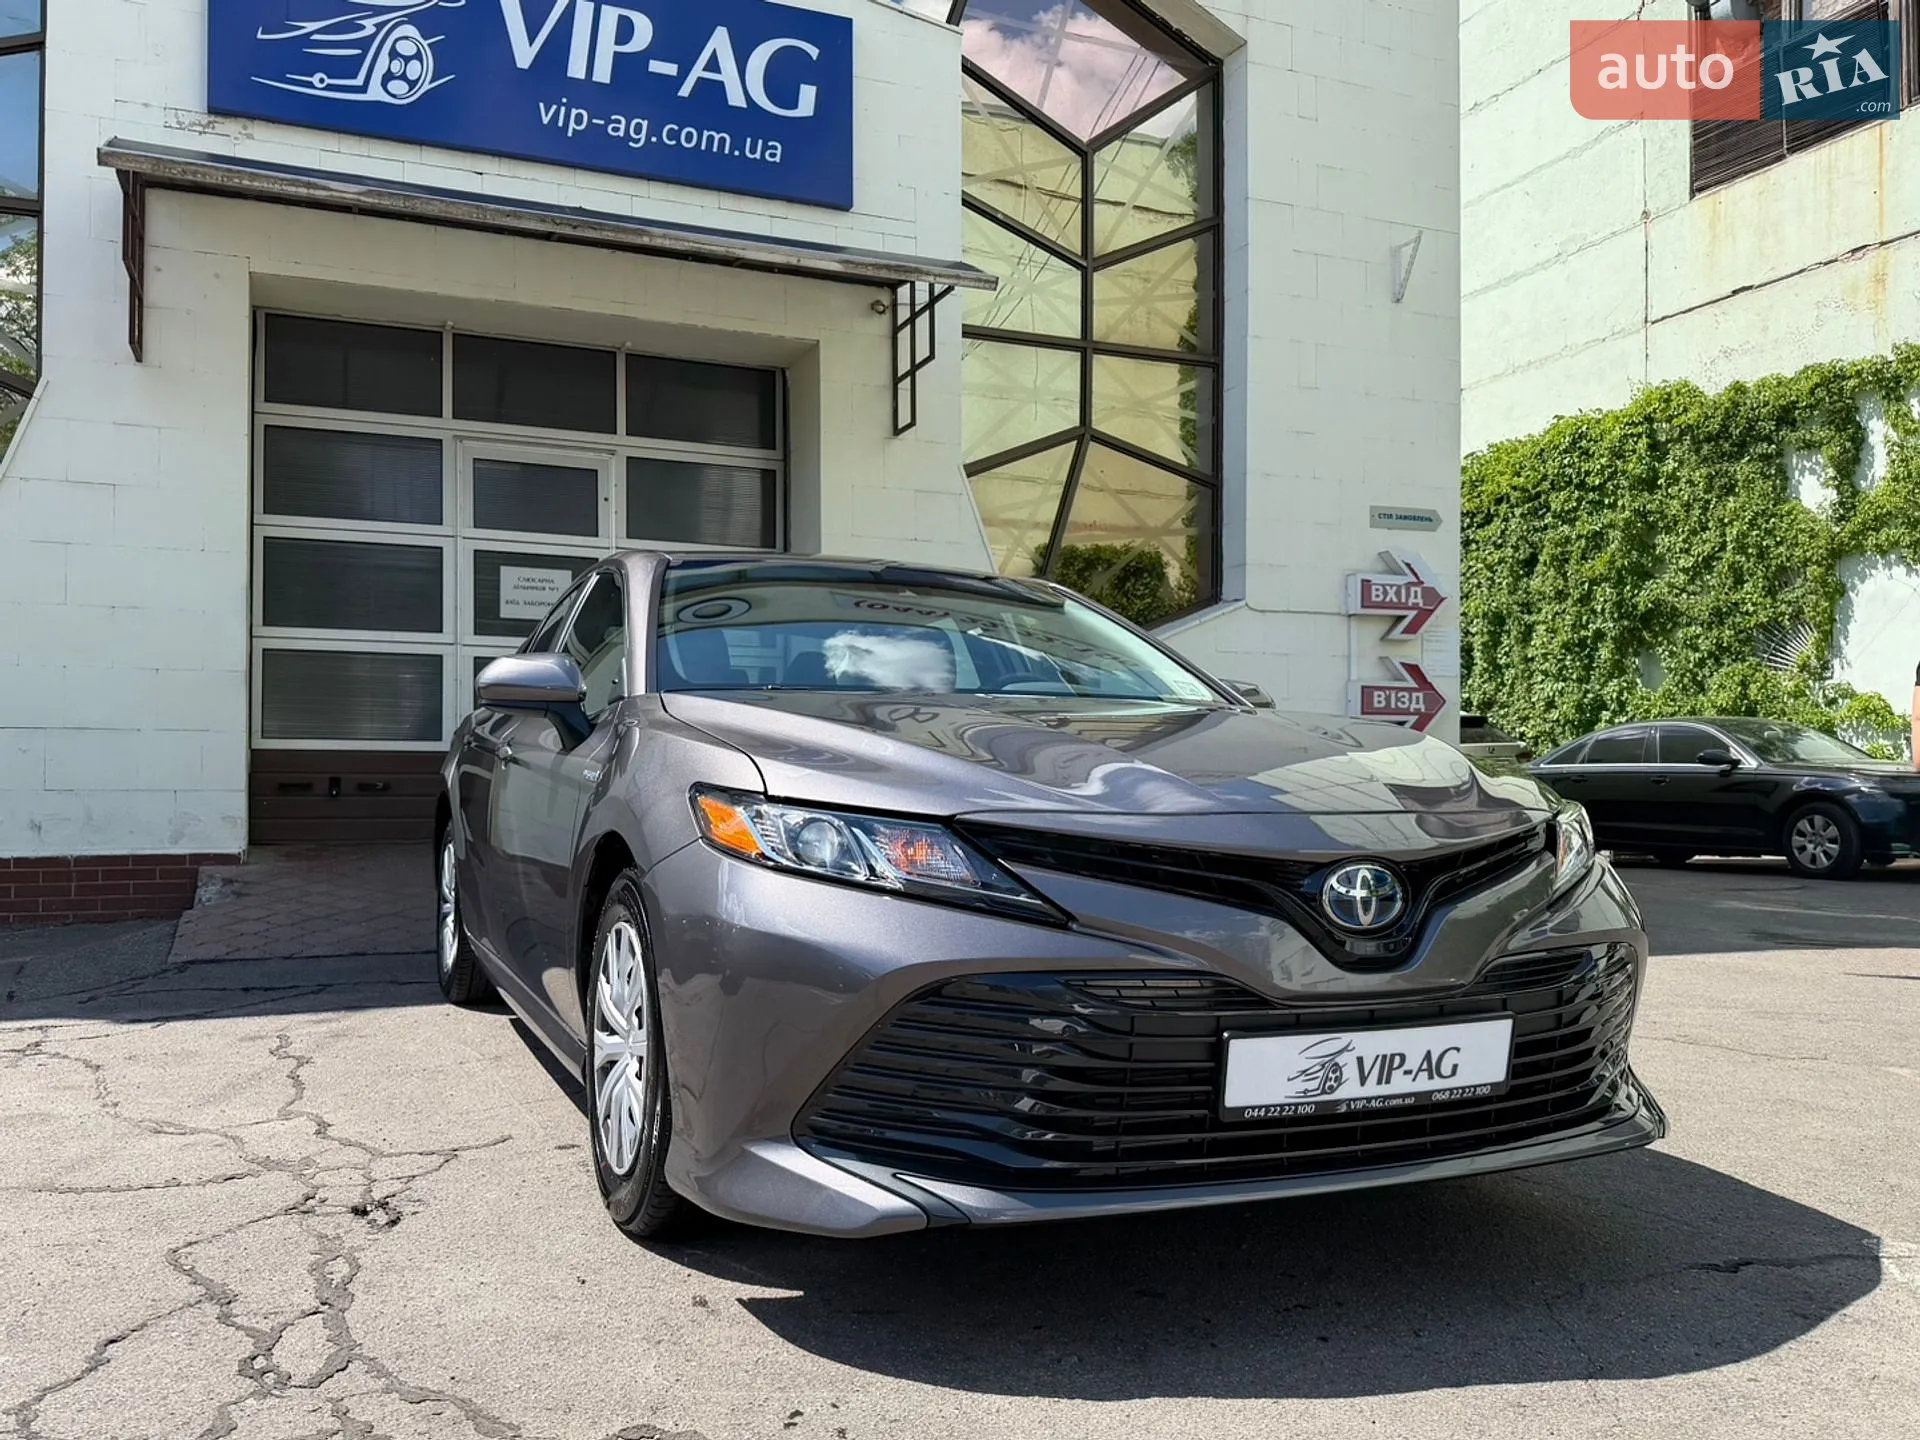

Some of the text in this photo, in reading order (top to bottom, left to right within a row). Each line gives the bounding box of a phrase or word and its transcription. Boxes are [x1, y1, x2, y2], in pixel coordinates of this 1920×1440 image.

[500, 0, 820, 118] VIP-AG
[538, 97, 784, 163] vip-ag.com.ua
[1371, 584, 1423, 607] ВХІД
[1356, 1046, 1461, 1087] VIP-AG
[1244, 1106, 1265, 1118] 044
